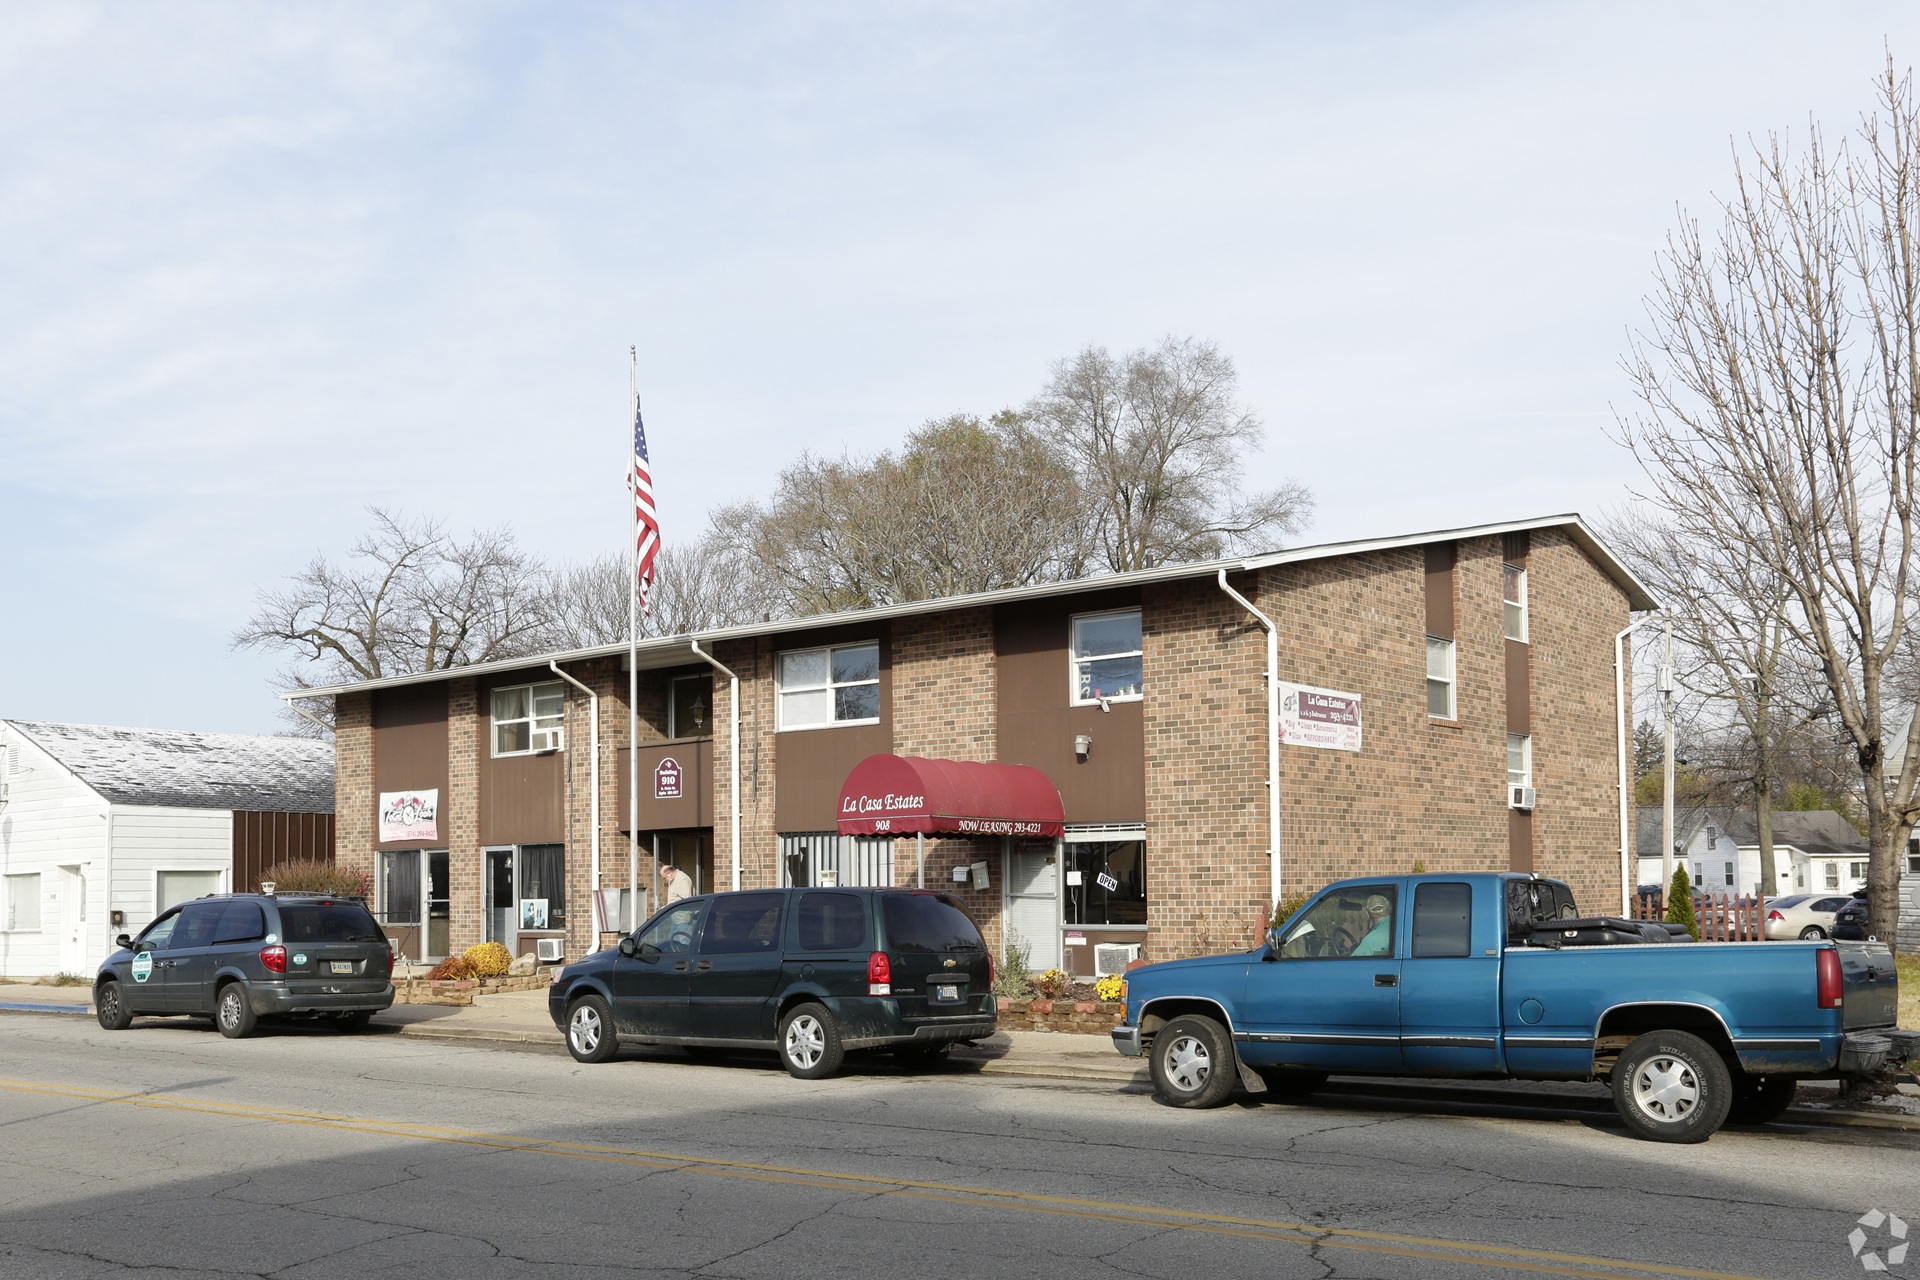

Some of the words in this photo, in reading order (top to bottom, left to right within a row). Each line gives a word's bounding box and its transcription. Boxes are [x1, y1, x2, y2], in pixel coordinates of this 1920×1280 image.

[1308, 694, 1315, 705] La
[1316, 695, 1328, 707] Casa
[1329, 697, 1346, 709] Estates
[661, 776, 676, 785] 910
[842, 796, 857, 812] La
[859, 795, 883, 813] Casa
[884, 793, 924, 810] Estates
[875, 820, 891, 831] 908
[958, 820, 980, 831] NOW
[979, 821, 1013, 835] LEASING
[1013, 822, 1041, 833] 293-4221
[1099, 874, 1117, 889] OPEN
[1659, 1045, 1708, 1097] WRANGLER
[1623, 1062, 1658, 1129] GOODYEAR
